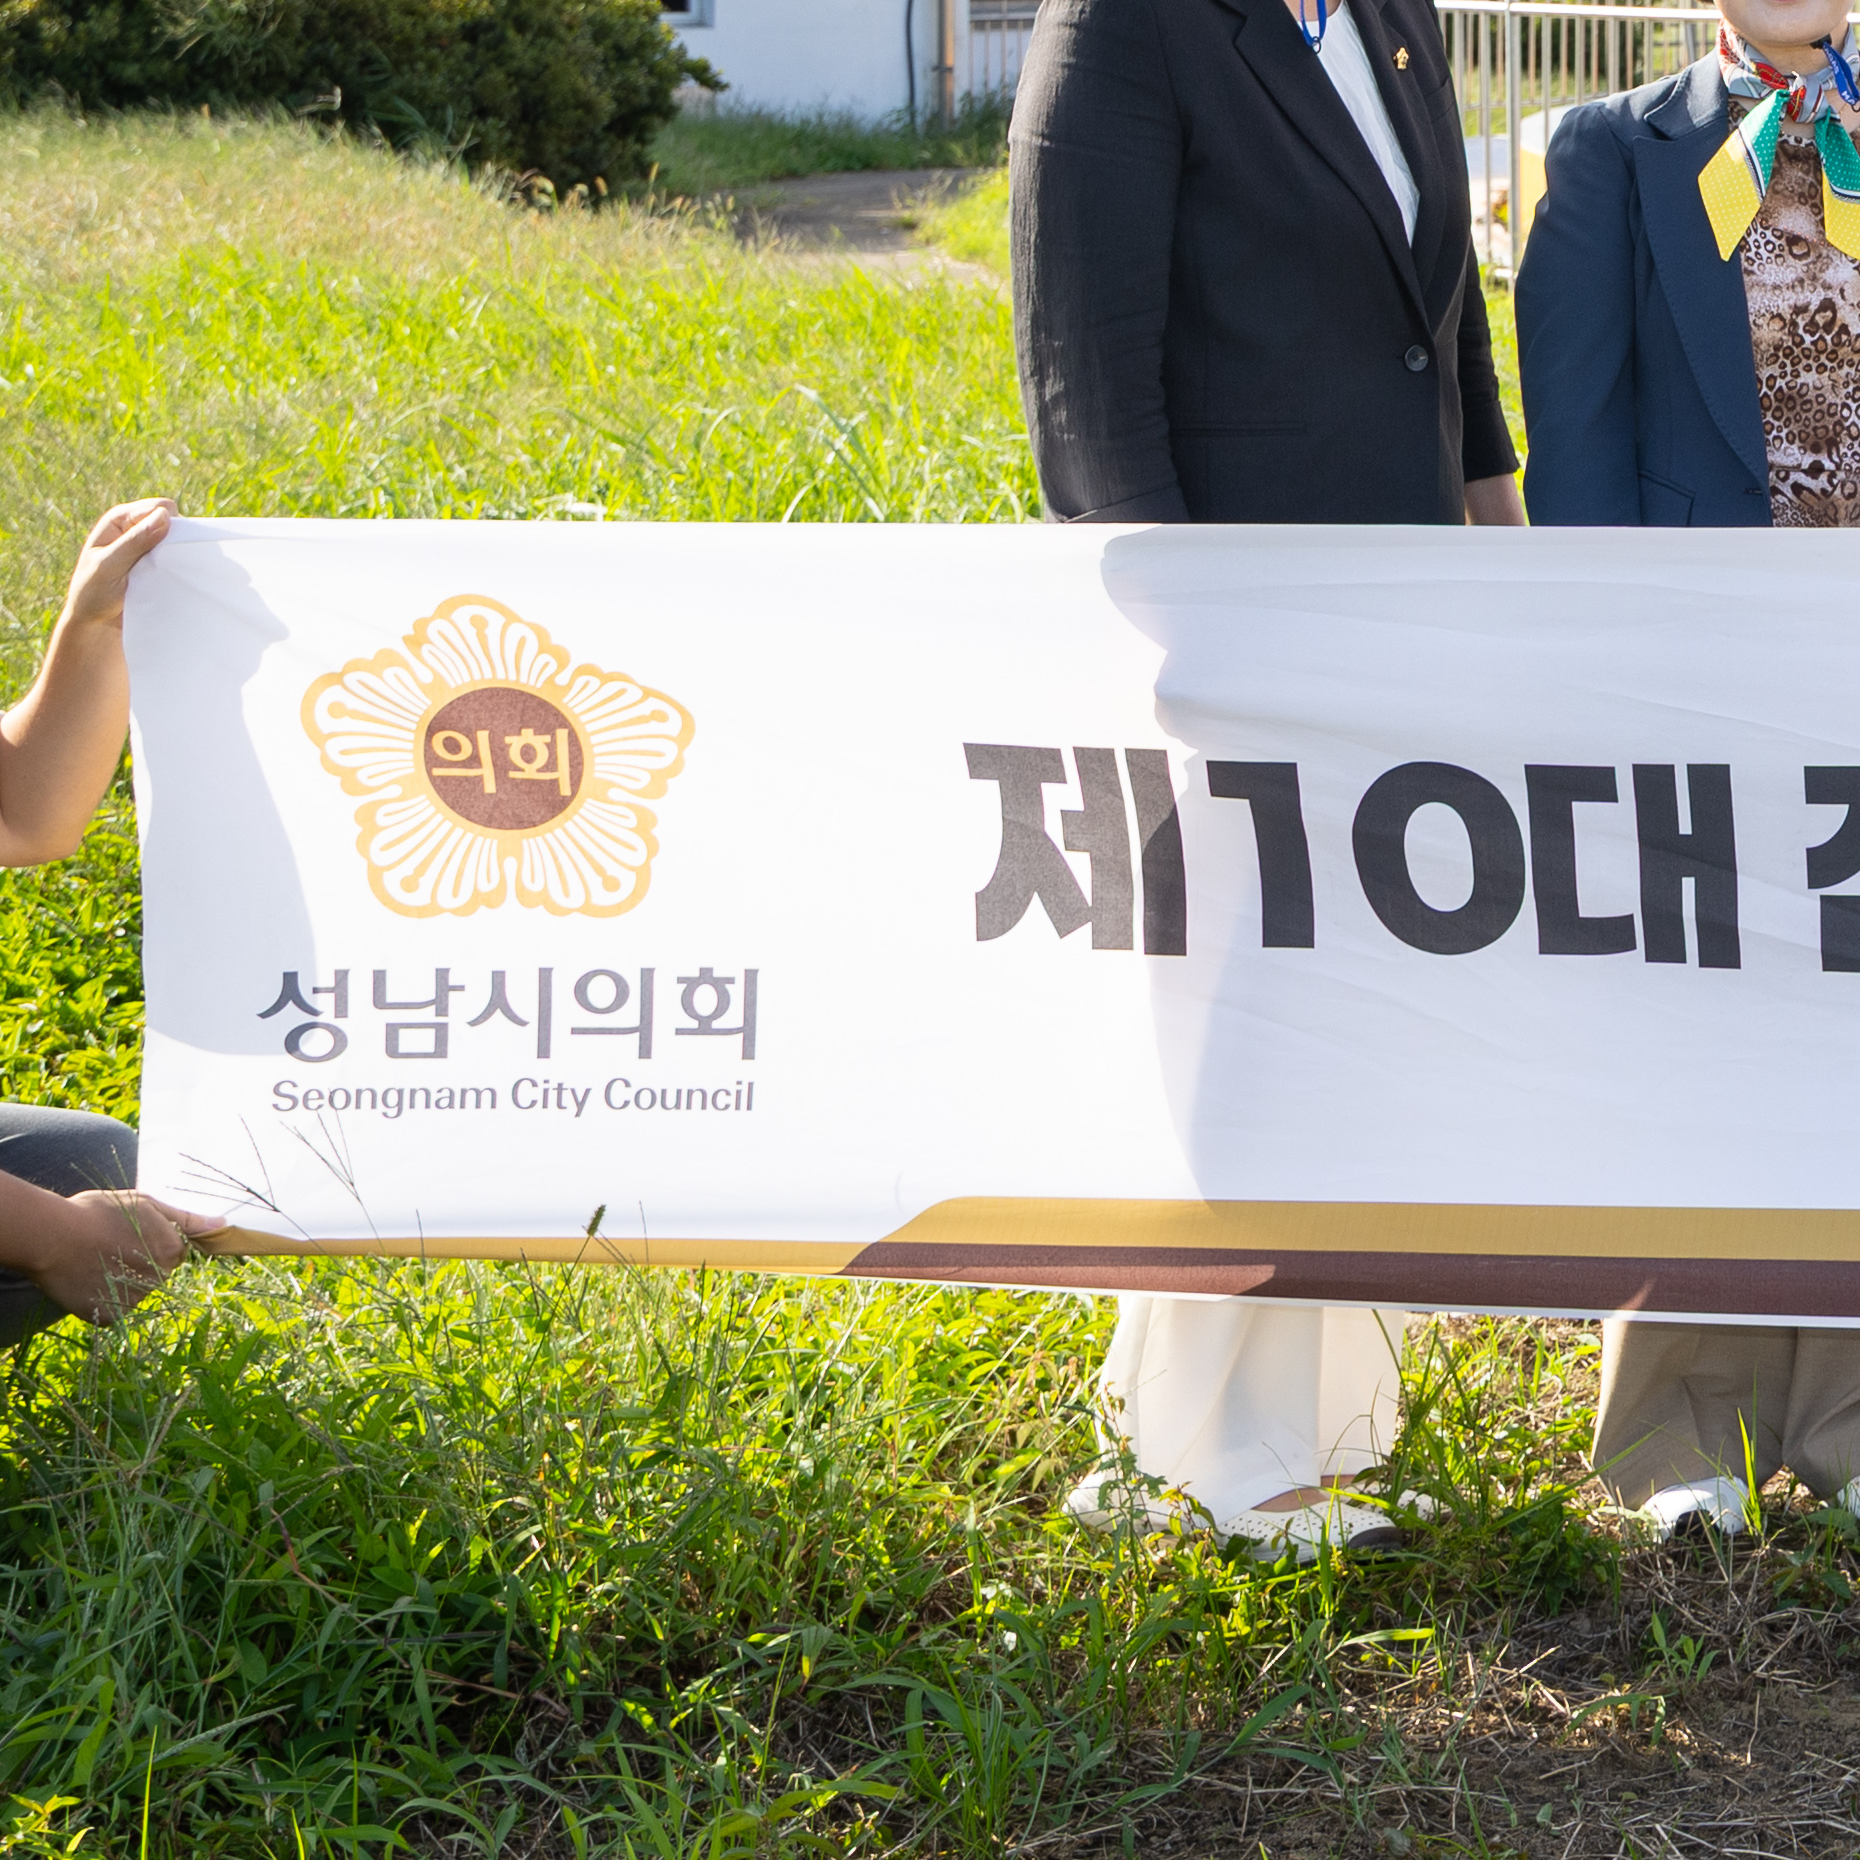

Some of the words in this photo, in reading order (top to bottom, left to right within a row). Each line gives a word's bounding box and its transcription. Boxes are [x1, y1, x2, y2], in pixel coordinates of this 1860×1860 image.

[431, 728, 572, 796] 의회
[962, 742, 1742, 970] 제10대
[255, 966, 760, 1063] 성남시의회
[271, 1078, 498, 1120] Seongnam
[511, 1077, 593, 1119] City
[603, 1078, 756, 1113] Council
